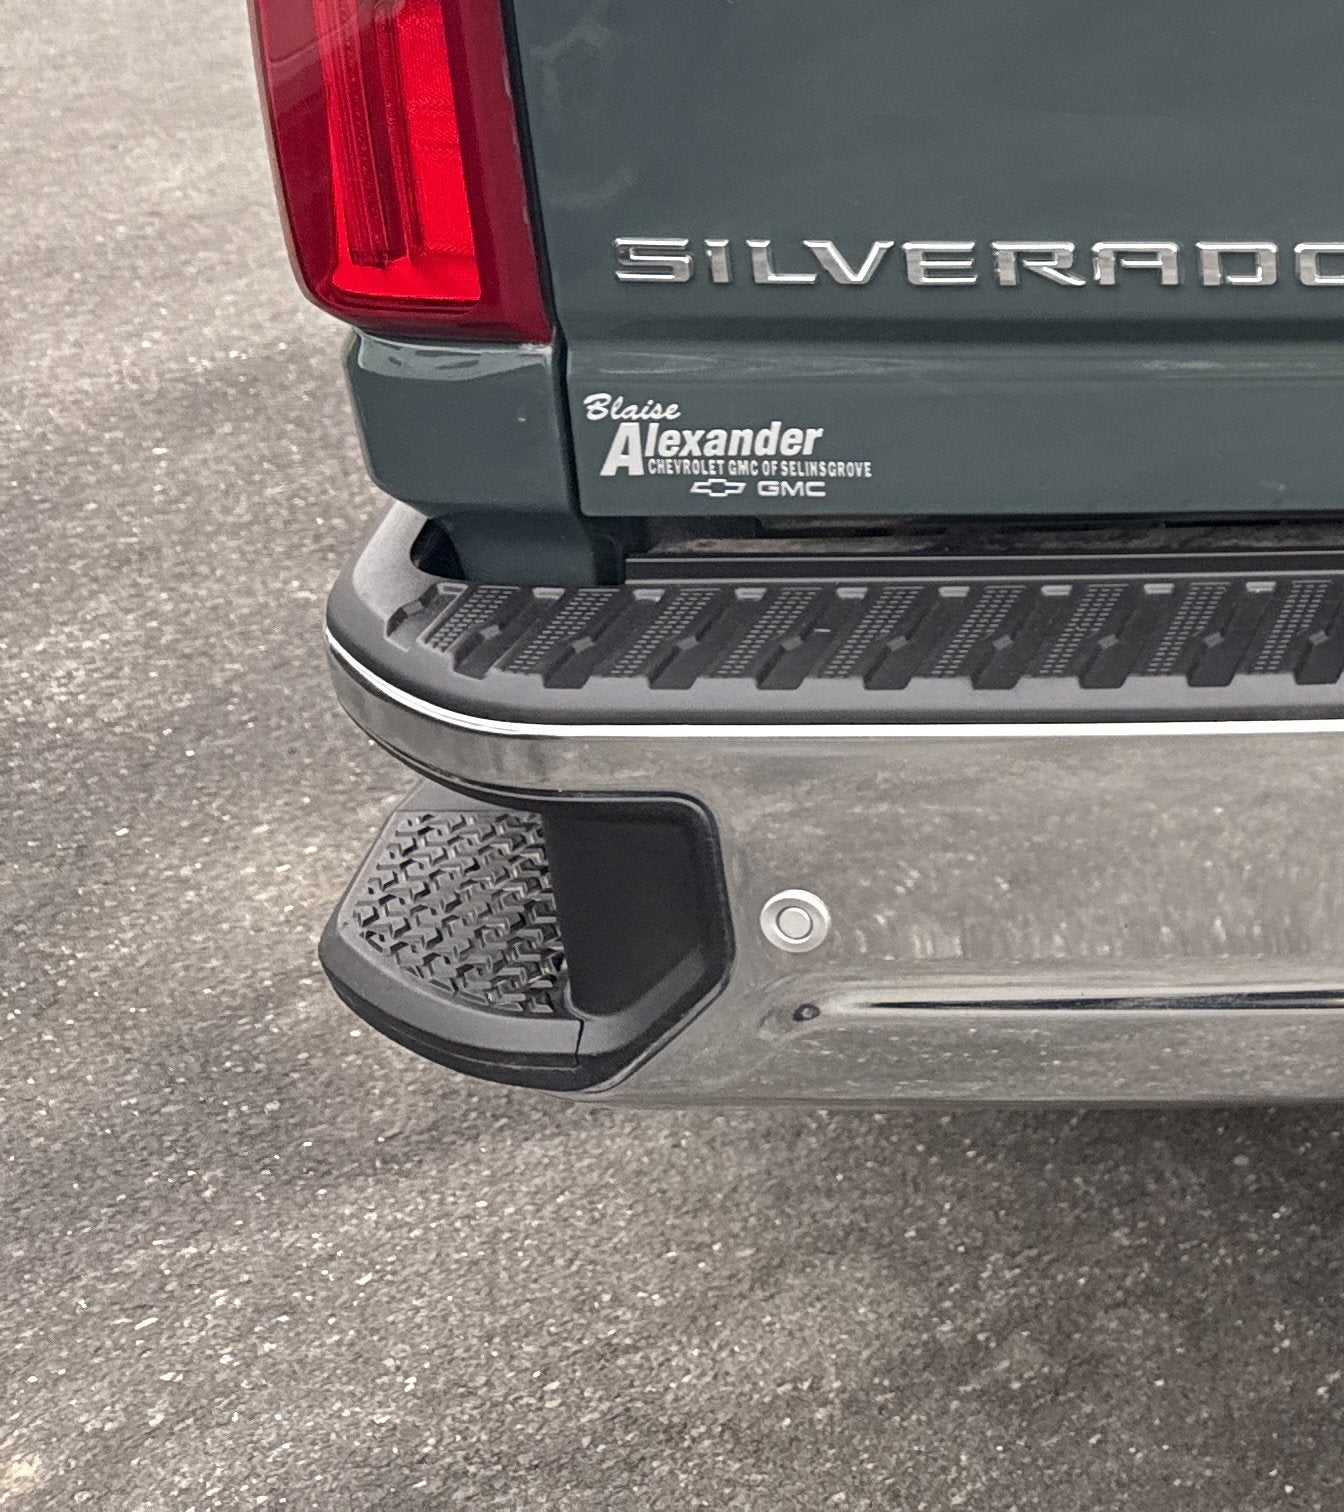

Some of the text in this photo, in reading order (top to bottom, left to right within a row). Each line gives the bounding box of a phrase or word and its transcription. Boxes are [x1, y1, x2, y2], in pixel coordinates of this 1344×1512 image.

[583, 393, 681, 420] Blaise
[600, 421, 824, 476] Alexander
[648, 458, 873, 478] CHEVROLET GMC OF SELINSGROVE
[757, 480, 826, 497] GMC
